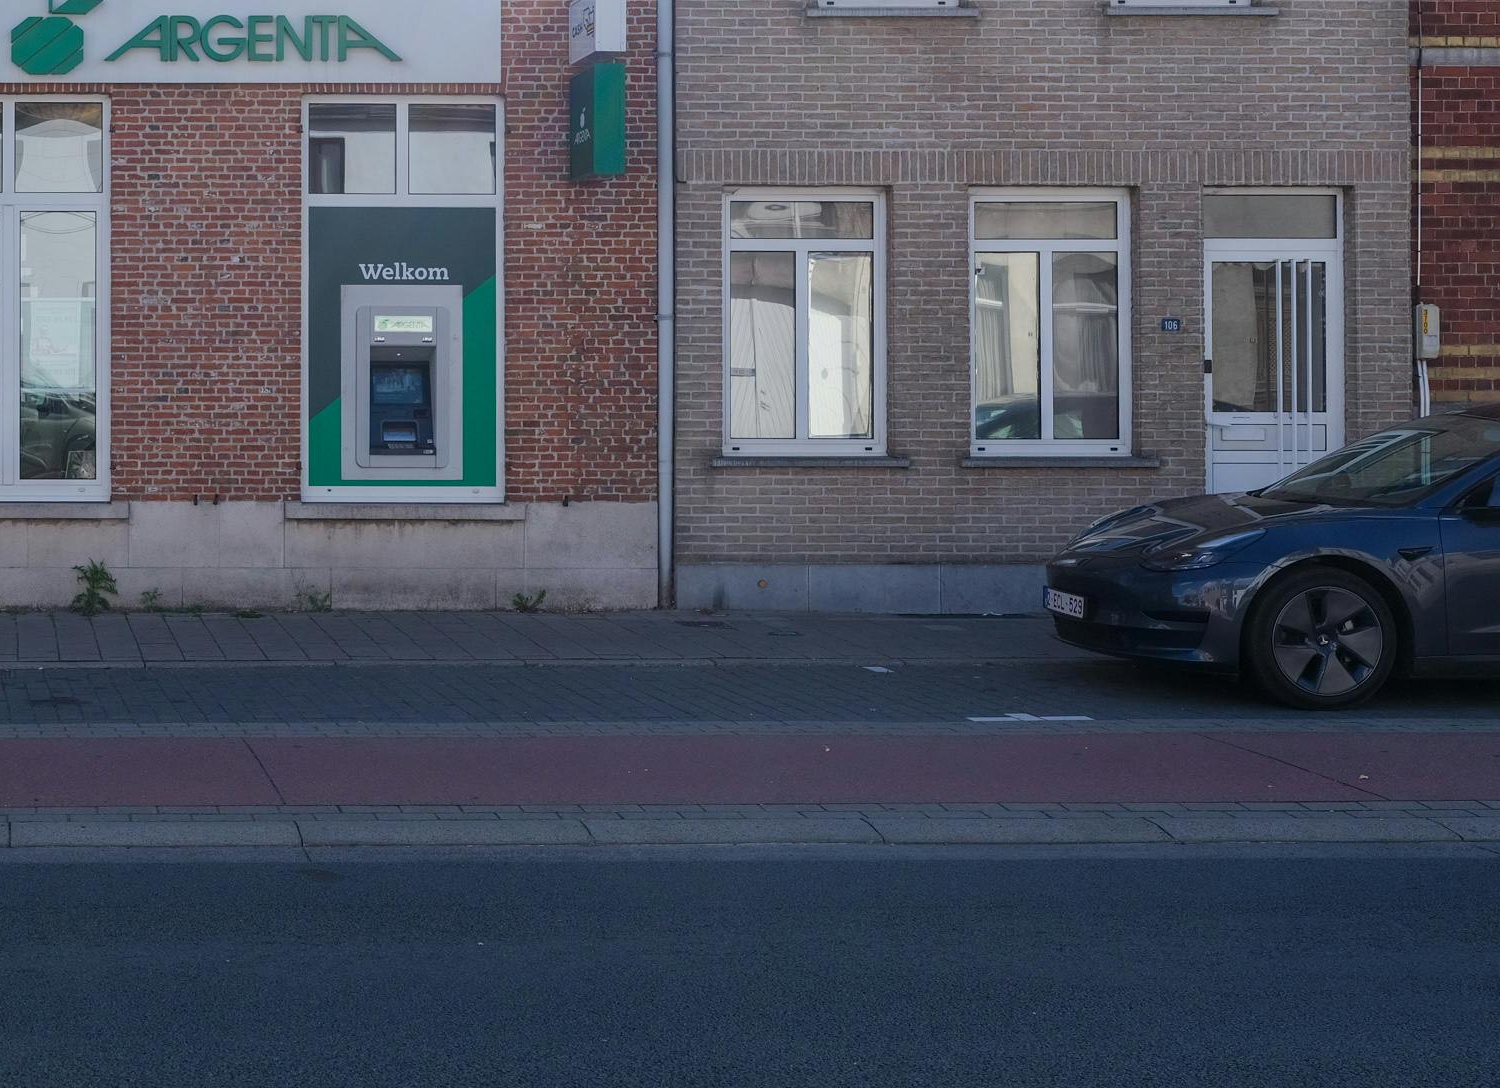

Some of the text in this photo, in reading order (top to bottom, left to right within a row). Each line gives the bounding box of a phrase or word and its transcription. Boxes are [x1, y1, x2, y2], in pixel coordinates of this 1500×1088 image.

[104, 15, 402, 62] ARGENTA
[572, 24, 583, 39] CASH
[359, 262, 449, 280] Welkom
[1164, 320, 1178, 330] 106
[1047, 591, 1083, 614] 2-ECL-529
